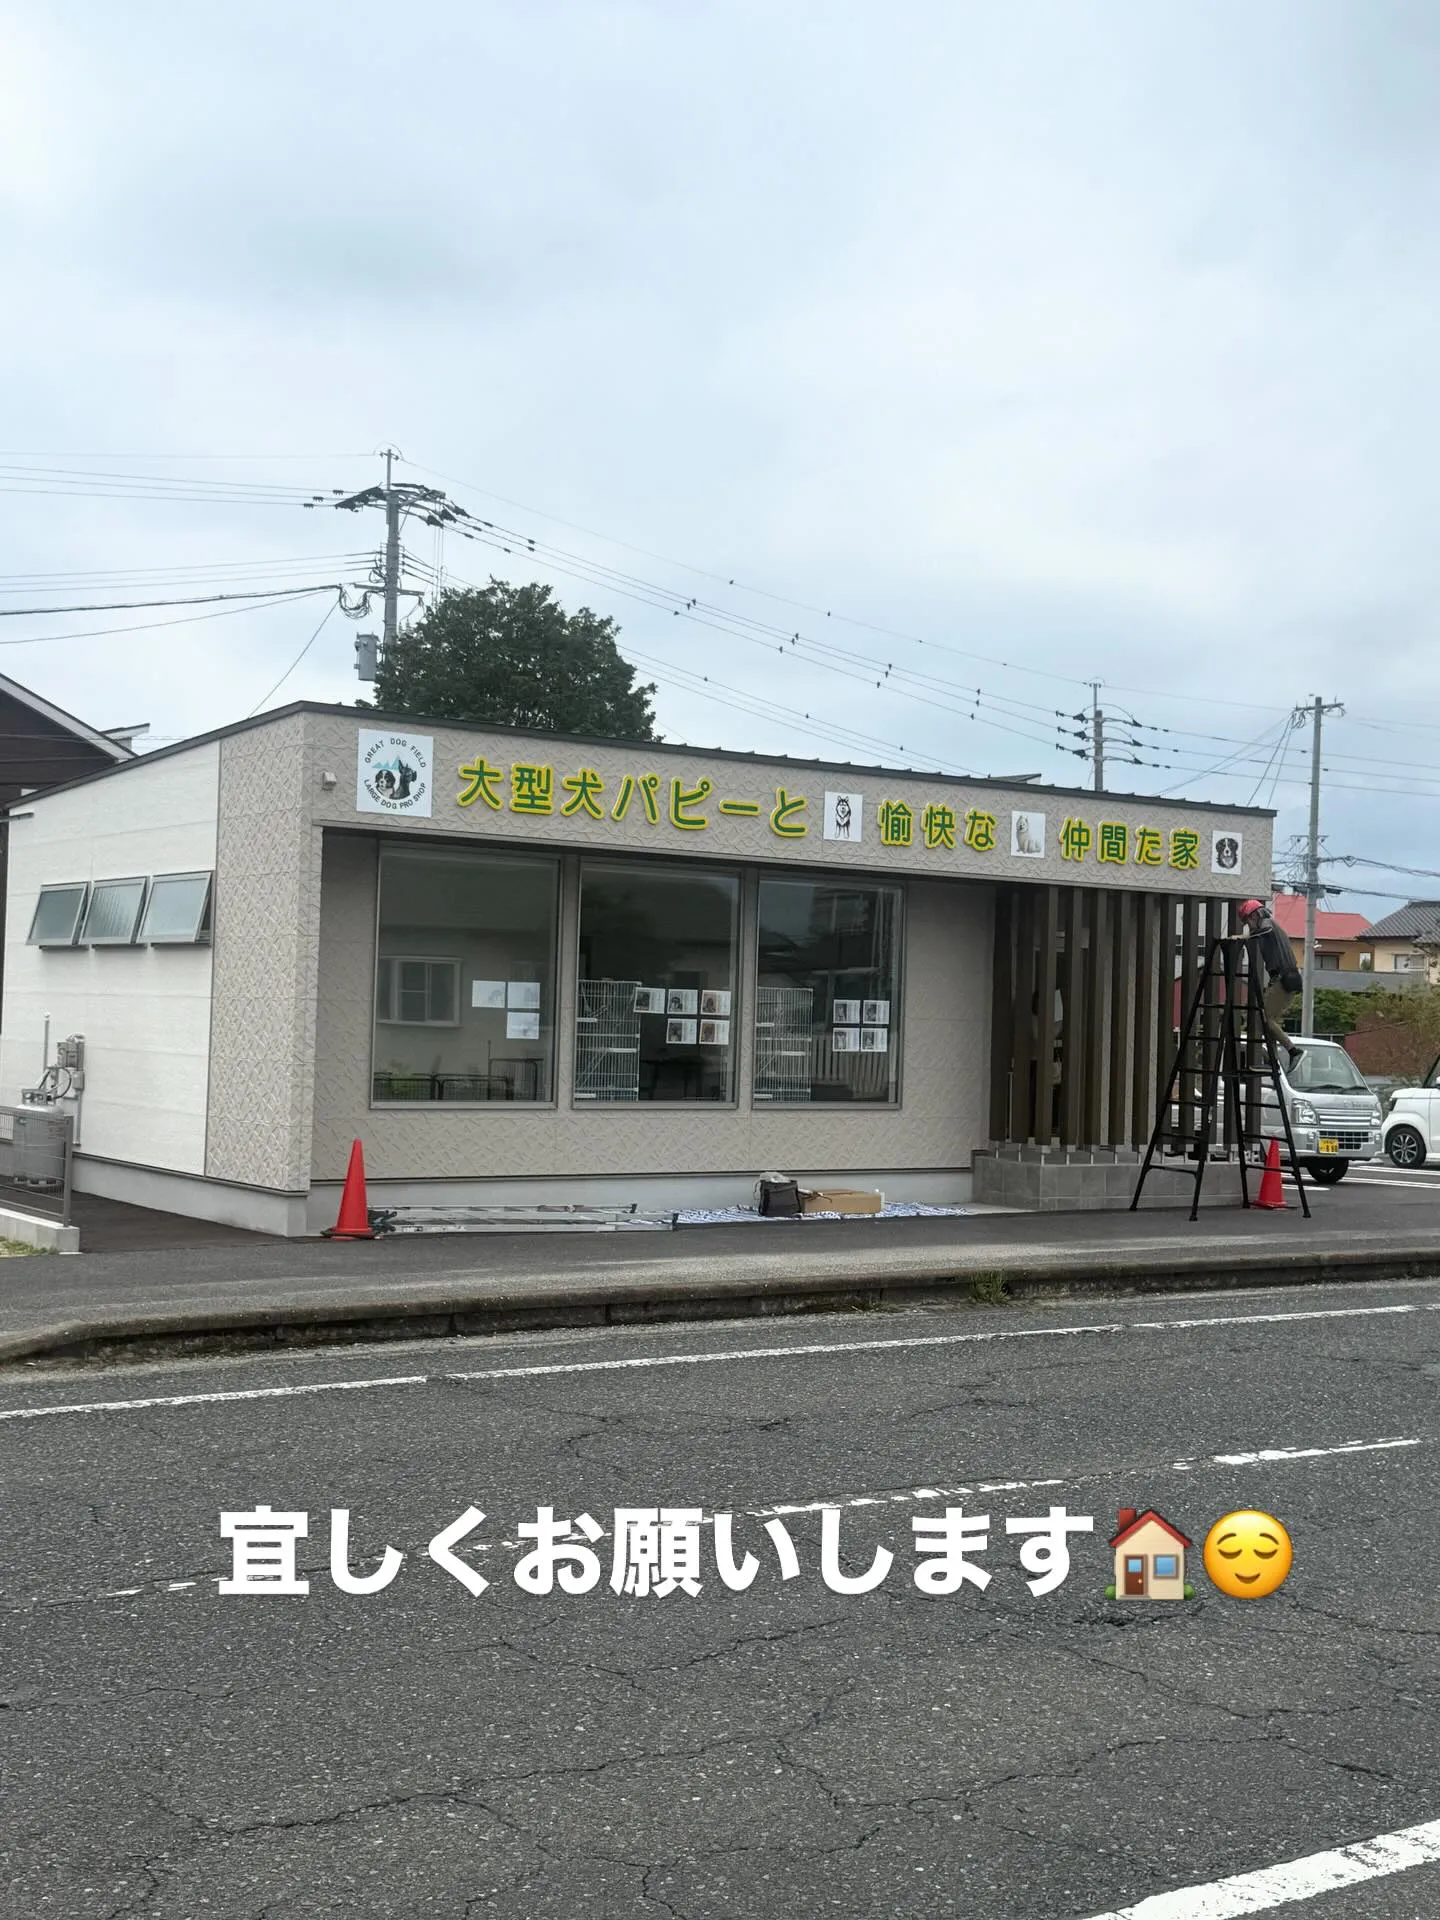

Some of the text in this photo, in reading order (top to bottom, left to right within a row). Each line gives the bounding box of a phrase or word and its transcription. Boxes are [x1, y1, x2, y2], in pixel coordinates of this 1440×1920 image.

[364, 737, 427, 768] GREAT DOG FIELD
[364, 779, 426, 809] LARGE DOG PRO SHOP
[458, 757, 1201, 871] 大型犬パピーと 愉快な 仲間た家
